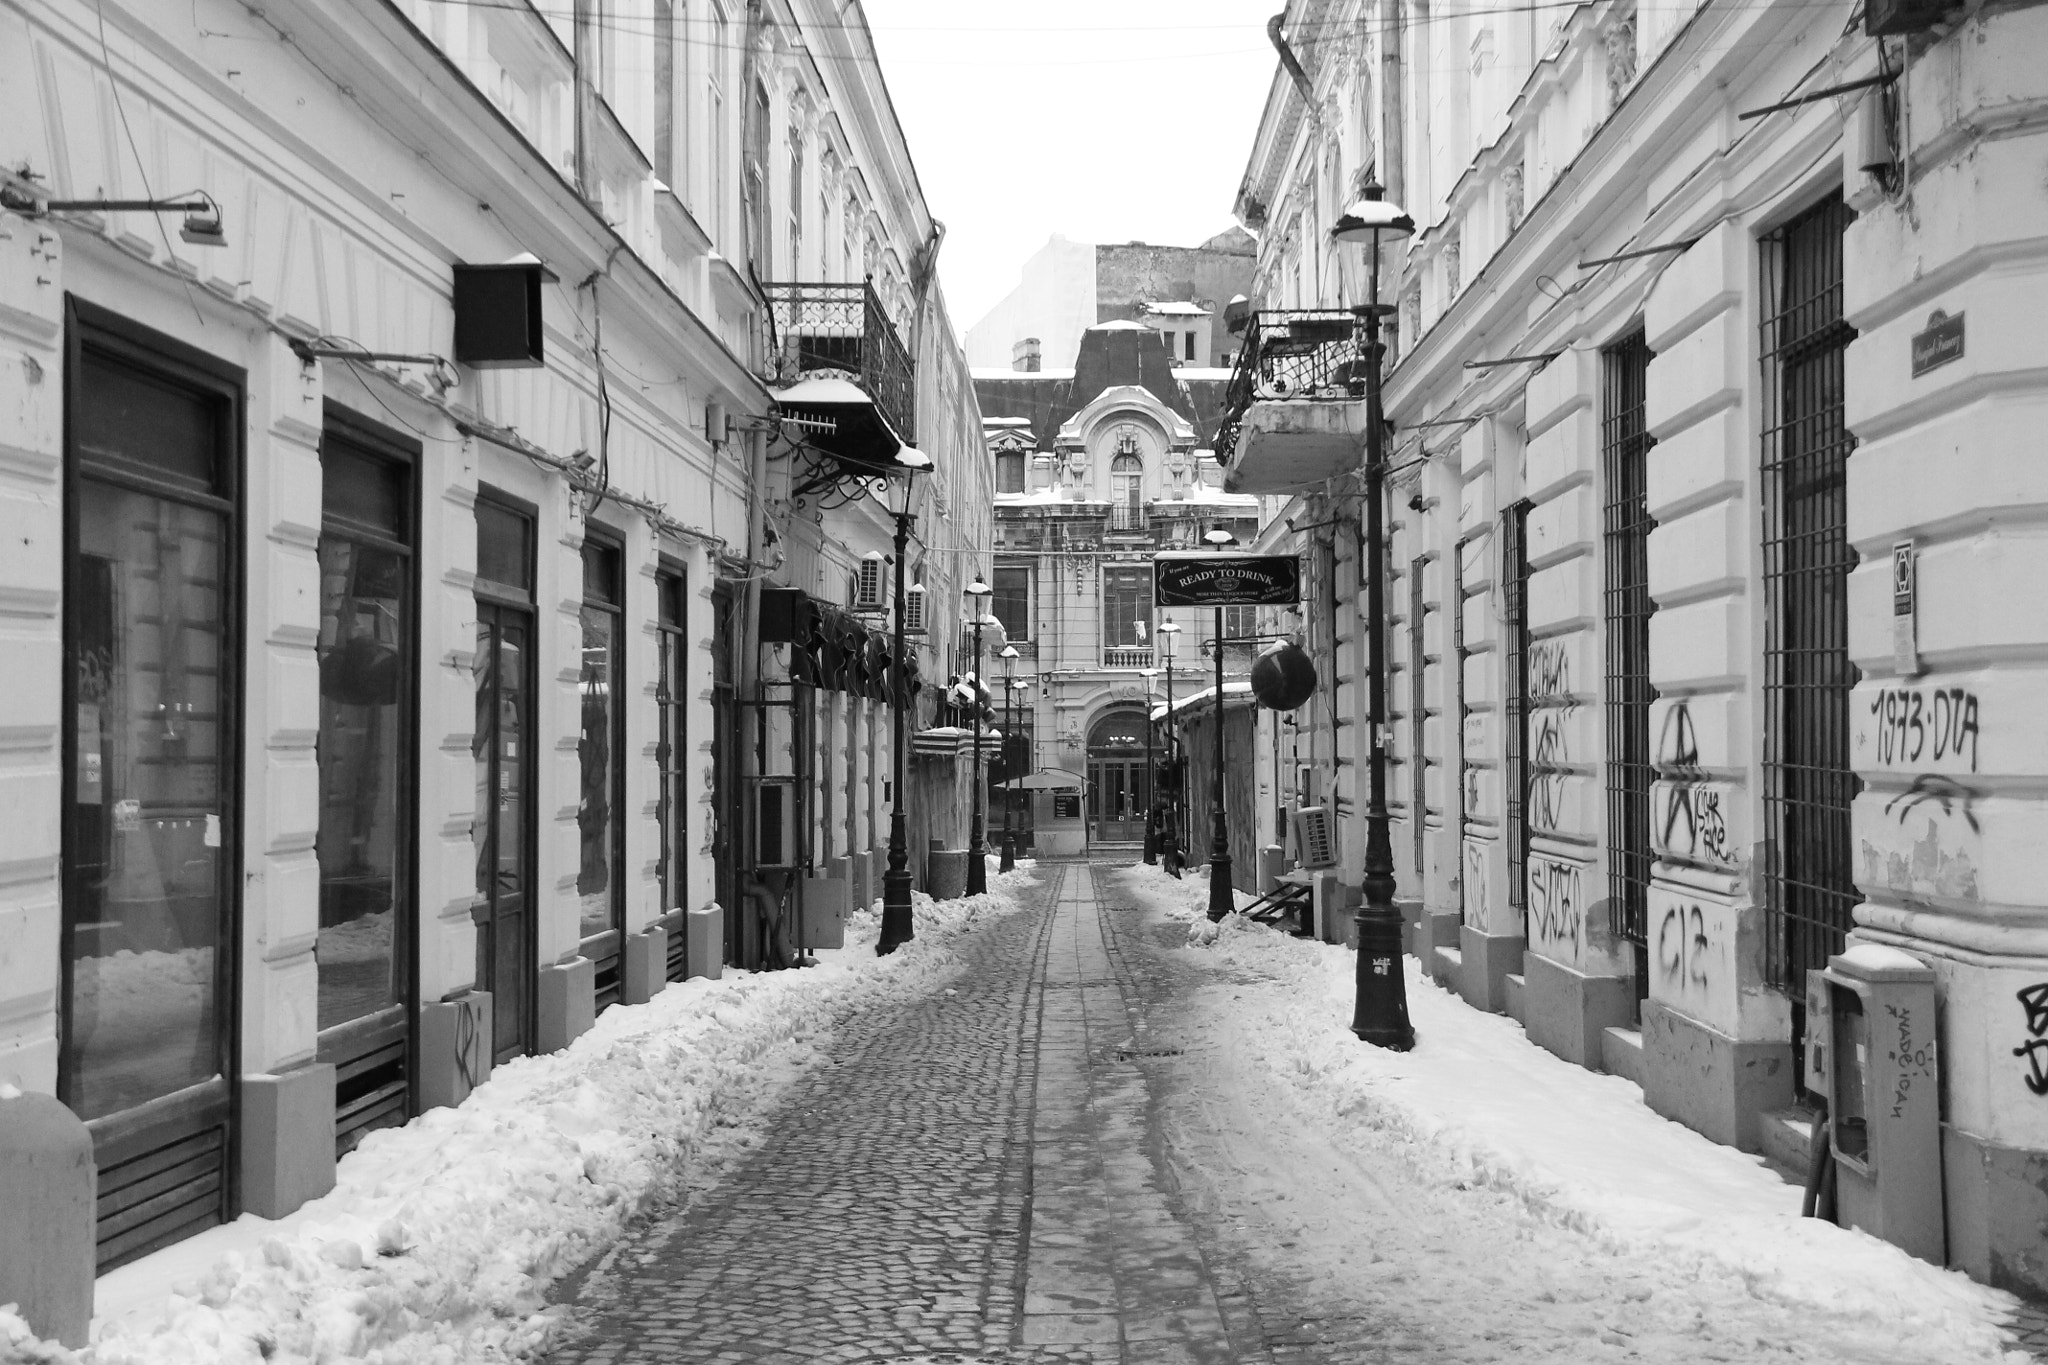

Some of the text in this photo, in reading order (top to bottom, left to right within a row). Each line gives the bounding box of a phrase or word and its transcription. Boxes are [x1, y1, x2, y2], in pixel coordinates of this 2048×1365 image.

[1179, 569, 1216, 588] READY
[1217, 569, 1235, 578] TO
[1237, 569, 1274, 585] DRINK
